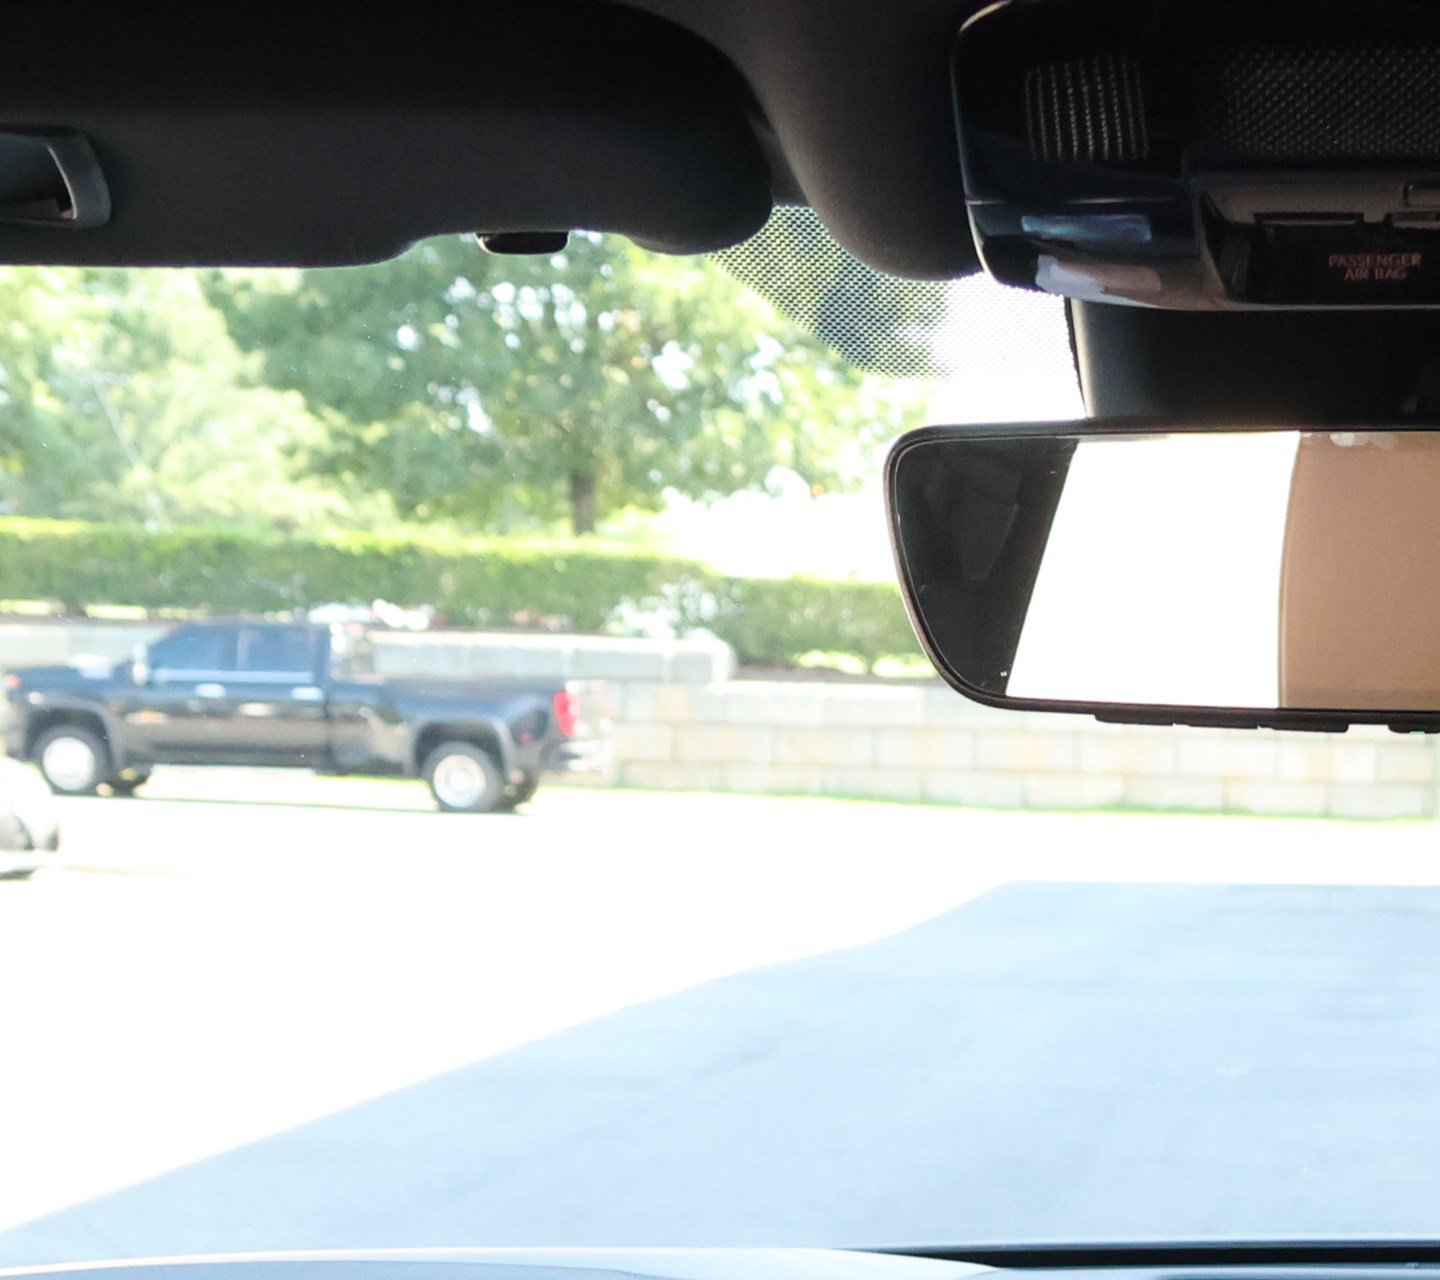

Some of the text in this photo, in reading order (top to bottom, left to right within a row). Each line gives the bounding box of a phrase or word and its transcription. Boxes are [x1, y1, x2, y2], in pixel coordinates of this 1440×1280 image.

[1328, 253, 1422, 267] PASSENGER
[1344, 267, 1407, 280] AIR BAG
